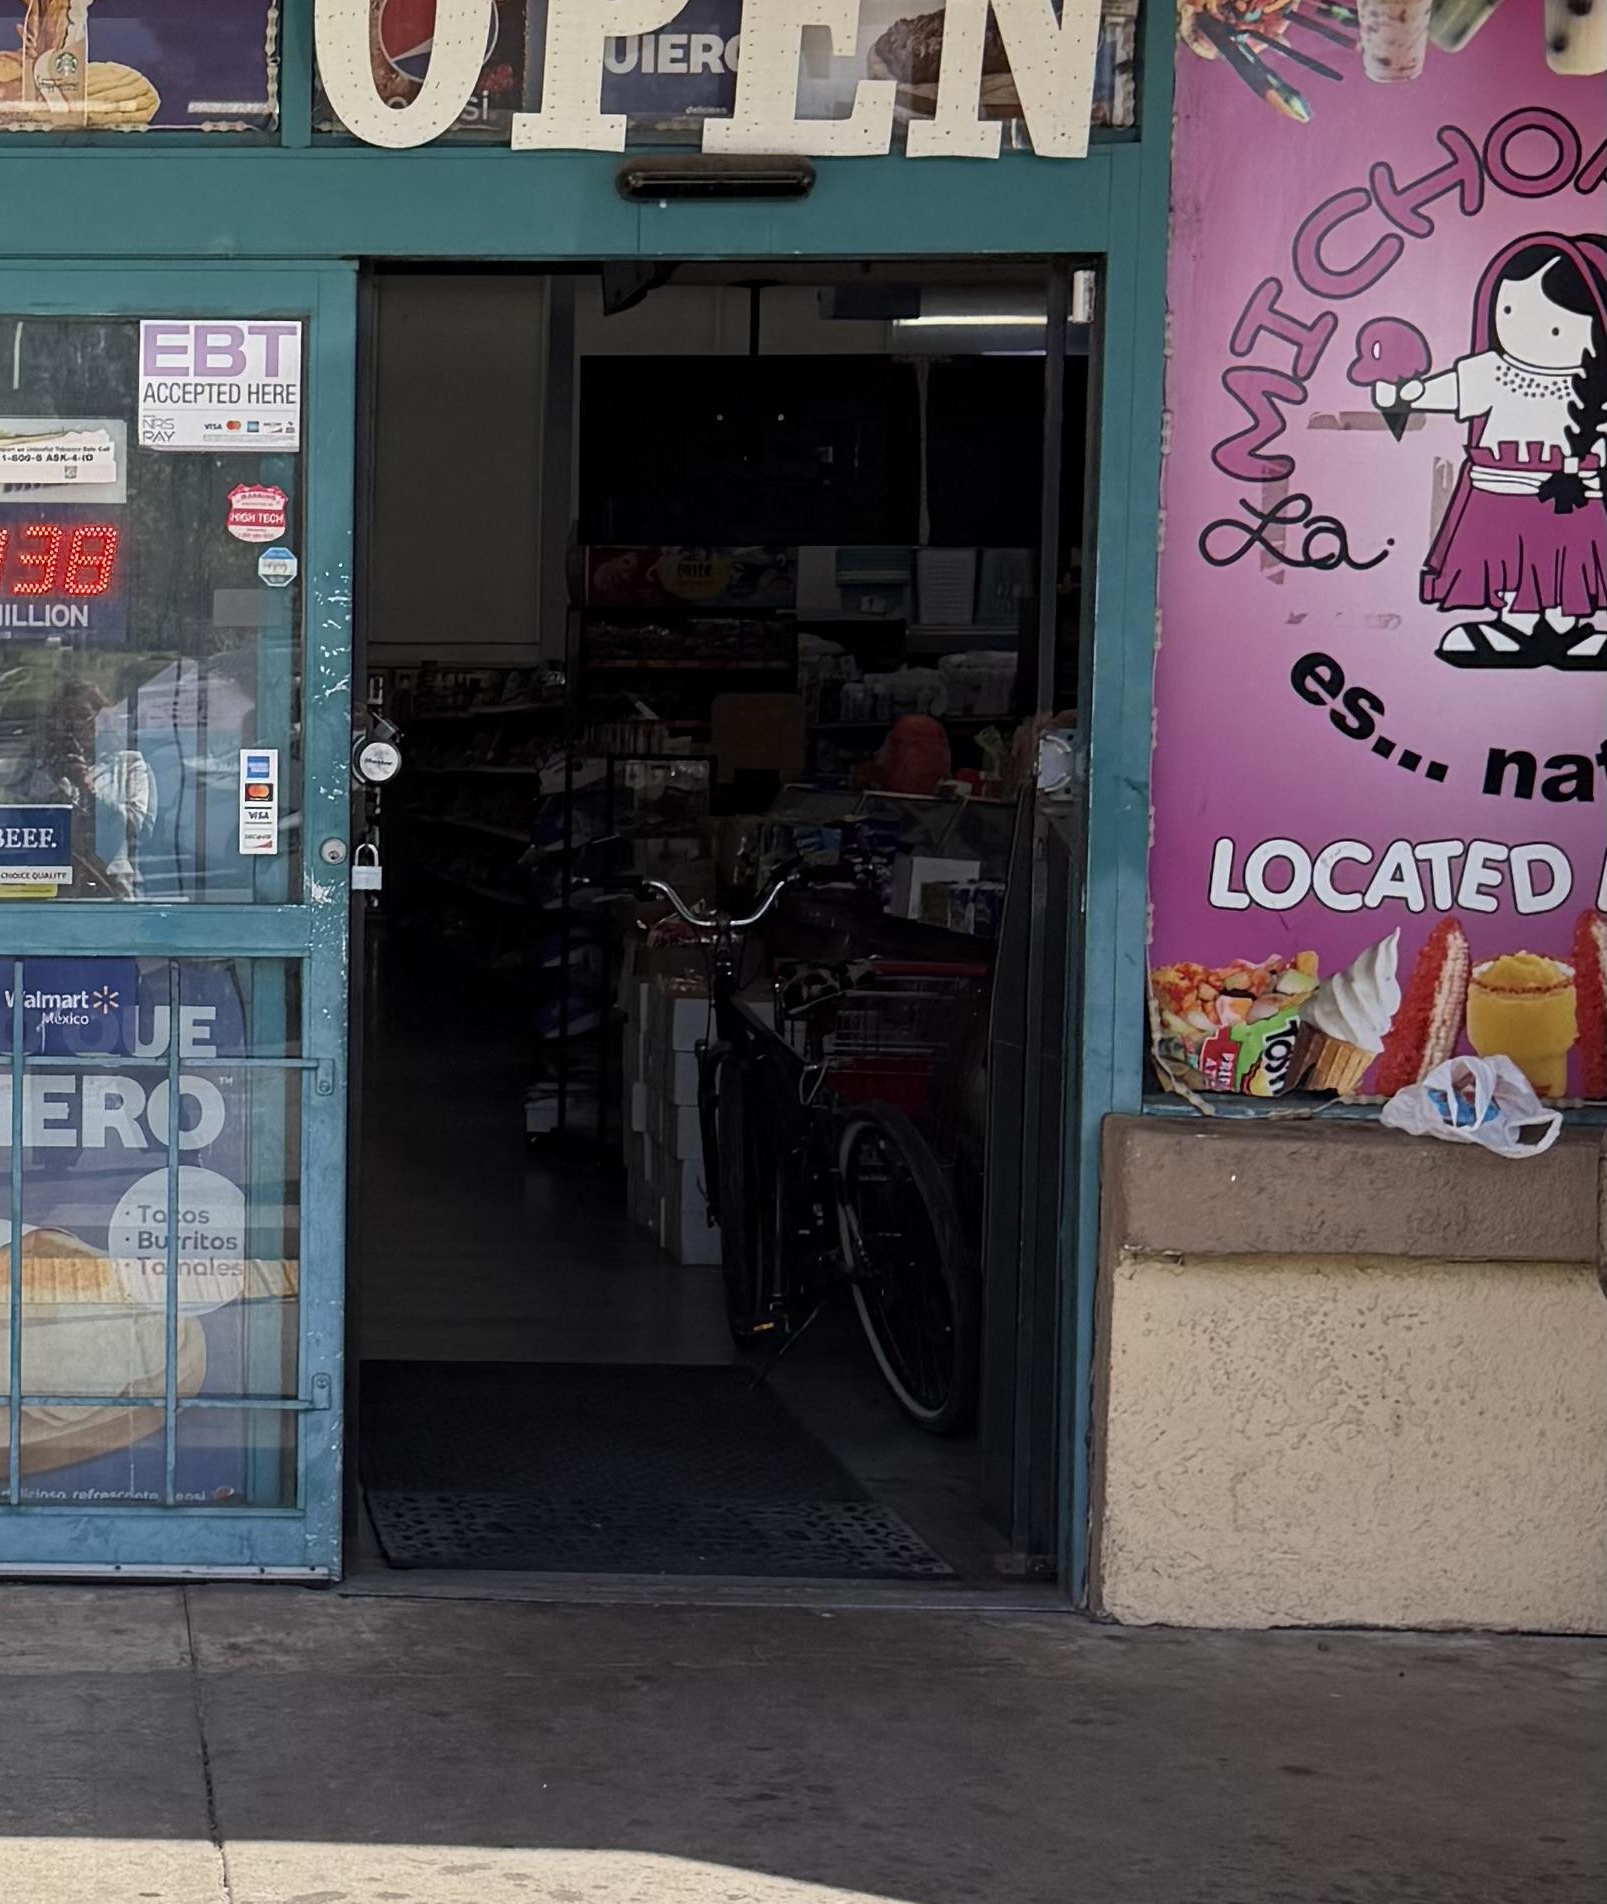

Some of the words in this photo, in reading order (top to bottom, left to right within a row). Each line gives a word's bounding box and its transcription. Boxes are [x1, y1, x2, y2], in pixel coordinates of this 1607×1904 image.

[603, 33, 741, 74] UIER
[1211, 105, 1607, 483] MICHO
[143, 325, 297, 377] EBT
[143, 383, 241, 404] ACCEPTED
[248, 384, 297, 404] HERE
[143, 431, 175, 442] PAY
[1198, 493, 1384, 571] La
[248, 811, 269, 819] VISA
[1209, 837, 1574, 916] LOCATED
[5, 990, 89, 1009] Walmart
[138, 1205, 210, 1224] Taos
[138, 1231, 238, 1250] Buritos
